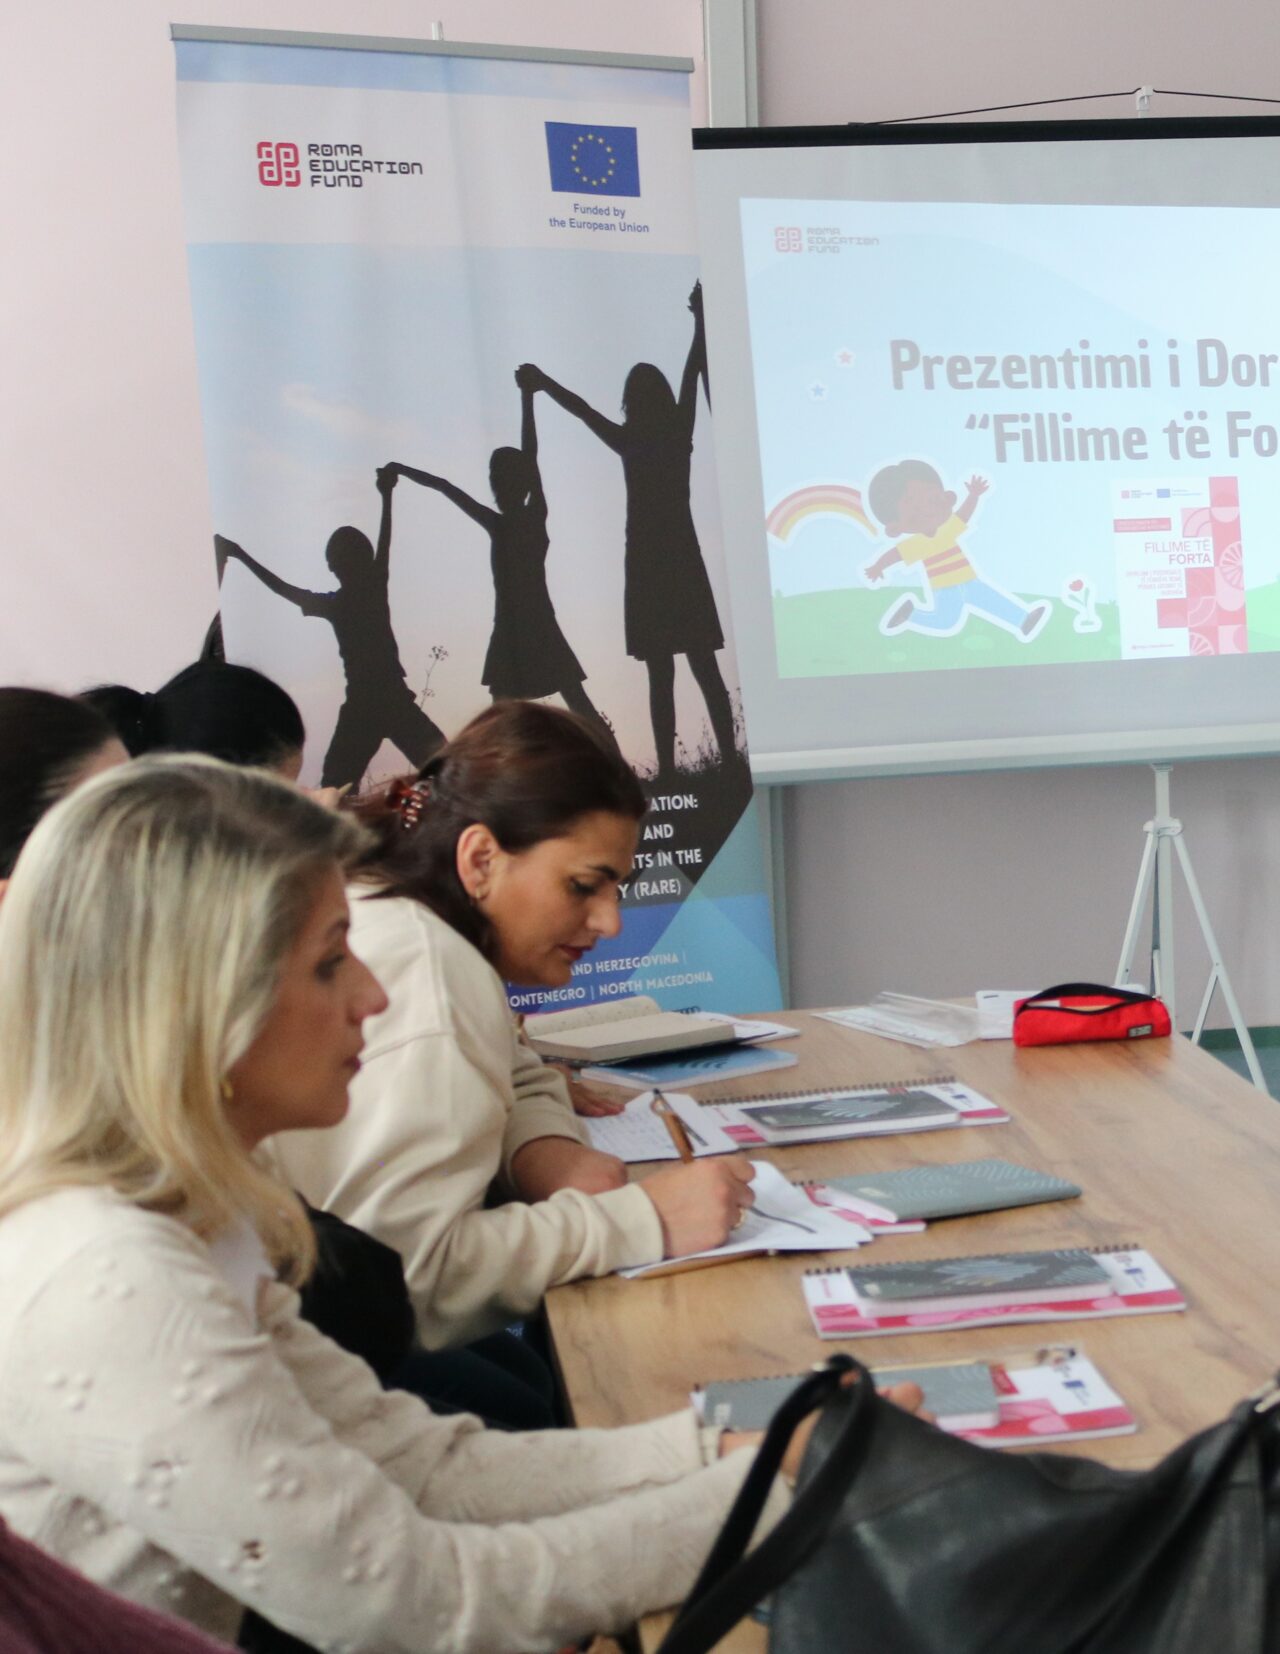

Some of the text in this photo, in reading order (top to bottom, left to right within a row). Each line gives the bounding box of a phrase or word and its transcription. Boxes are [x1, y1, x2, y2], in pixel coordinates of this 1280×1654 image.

[308, 143, 363, 157] ROMA
[309, 159, 423, 176] EDUCATION
[310, 174, 364, 188] FUND
[573, 203, 626, 219] Funded by
[549, 217, 650, 233] the European Union
[807, 227, 841, 236] ROMA
[807, 235, 880, 246] EDUCATION
[808, 245, 841, 254] FUND
[889, 338, 1152, 391] Prezentimi
[1167, 338, 1182, 389] i
[1162, 410, 1211, 461] të
[1144, 541, 1192, 553] FILLIME
[1169, 553, 1211, 564] FORTA
[643, 824, 674, 841] AND
[656, 851, 673, 867] IN
[675, 848, 703, 865] THE
[634, 879, 682, 901] (RARE)
[595, 951, 679, 974] HERZEGOVINA
[507, 987, 586, 1008] ONTENEGRO
[599, 979, 643, 997] NORTH
[646, 970, 714, 989] MACEDONIA
